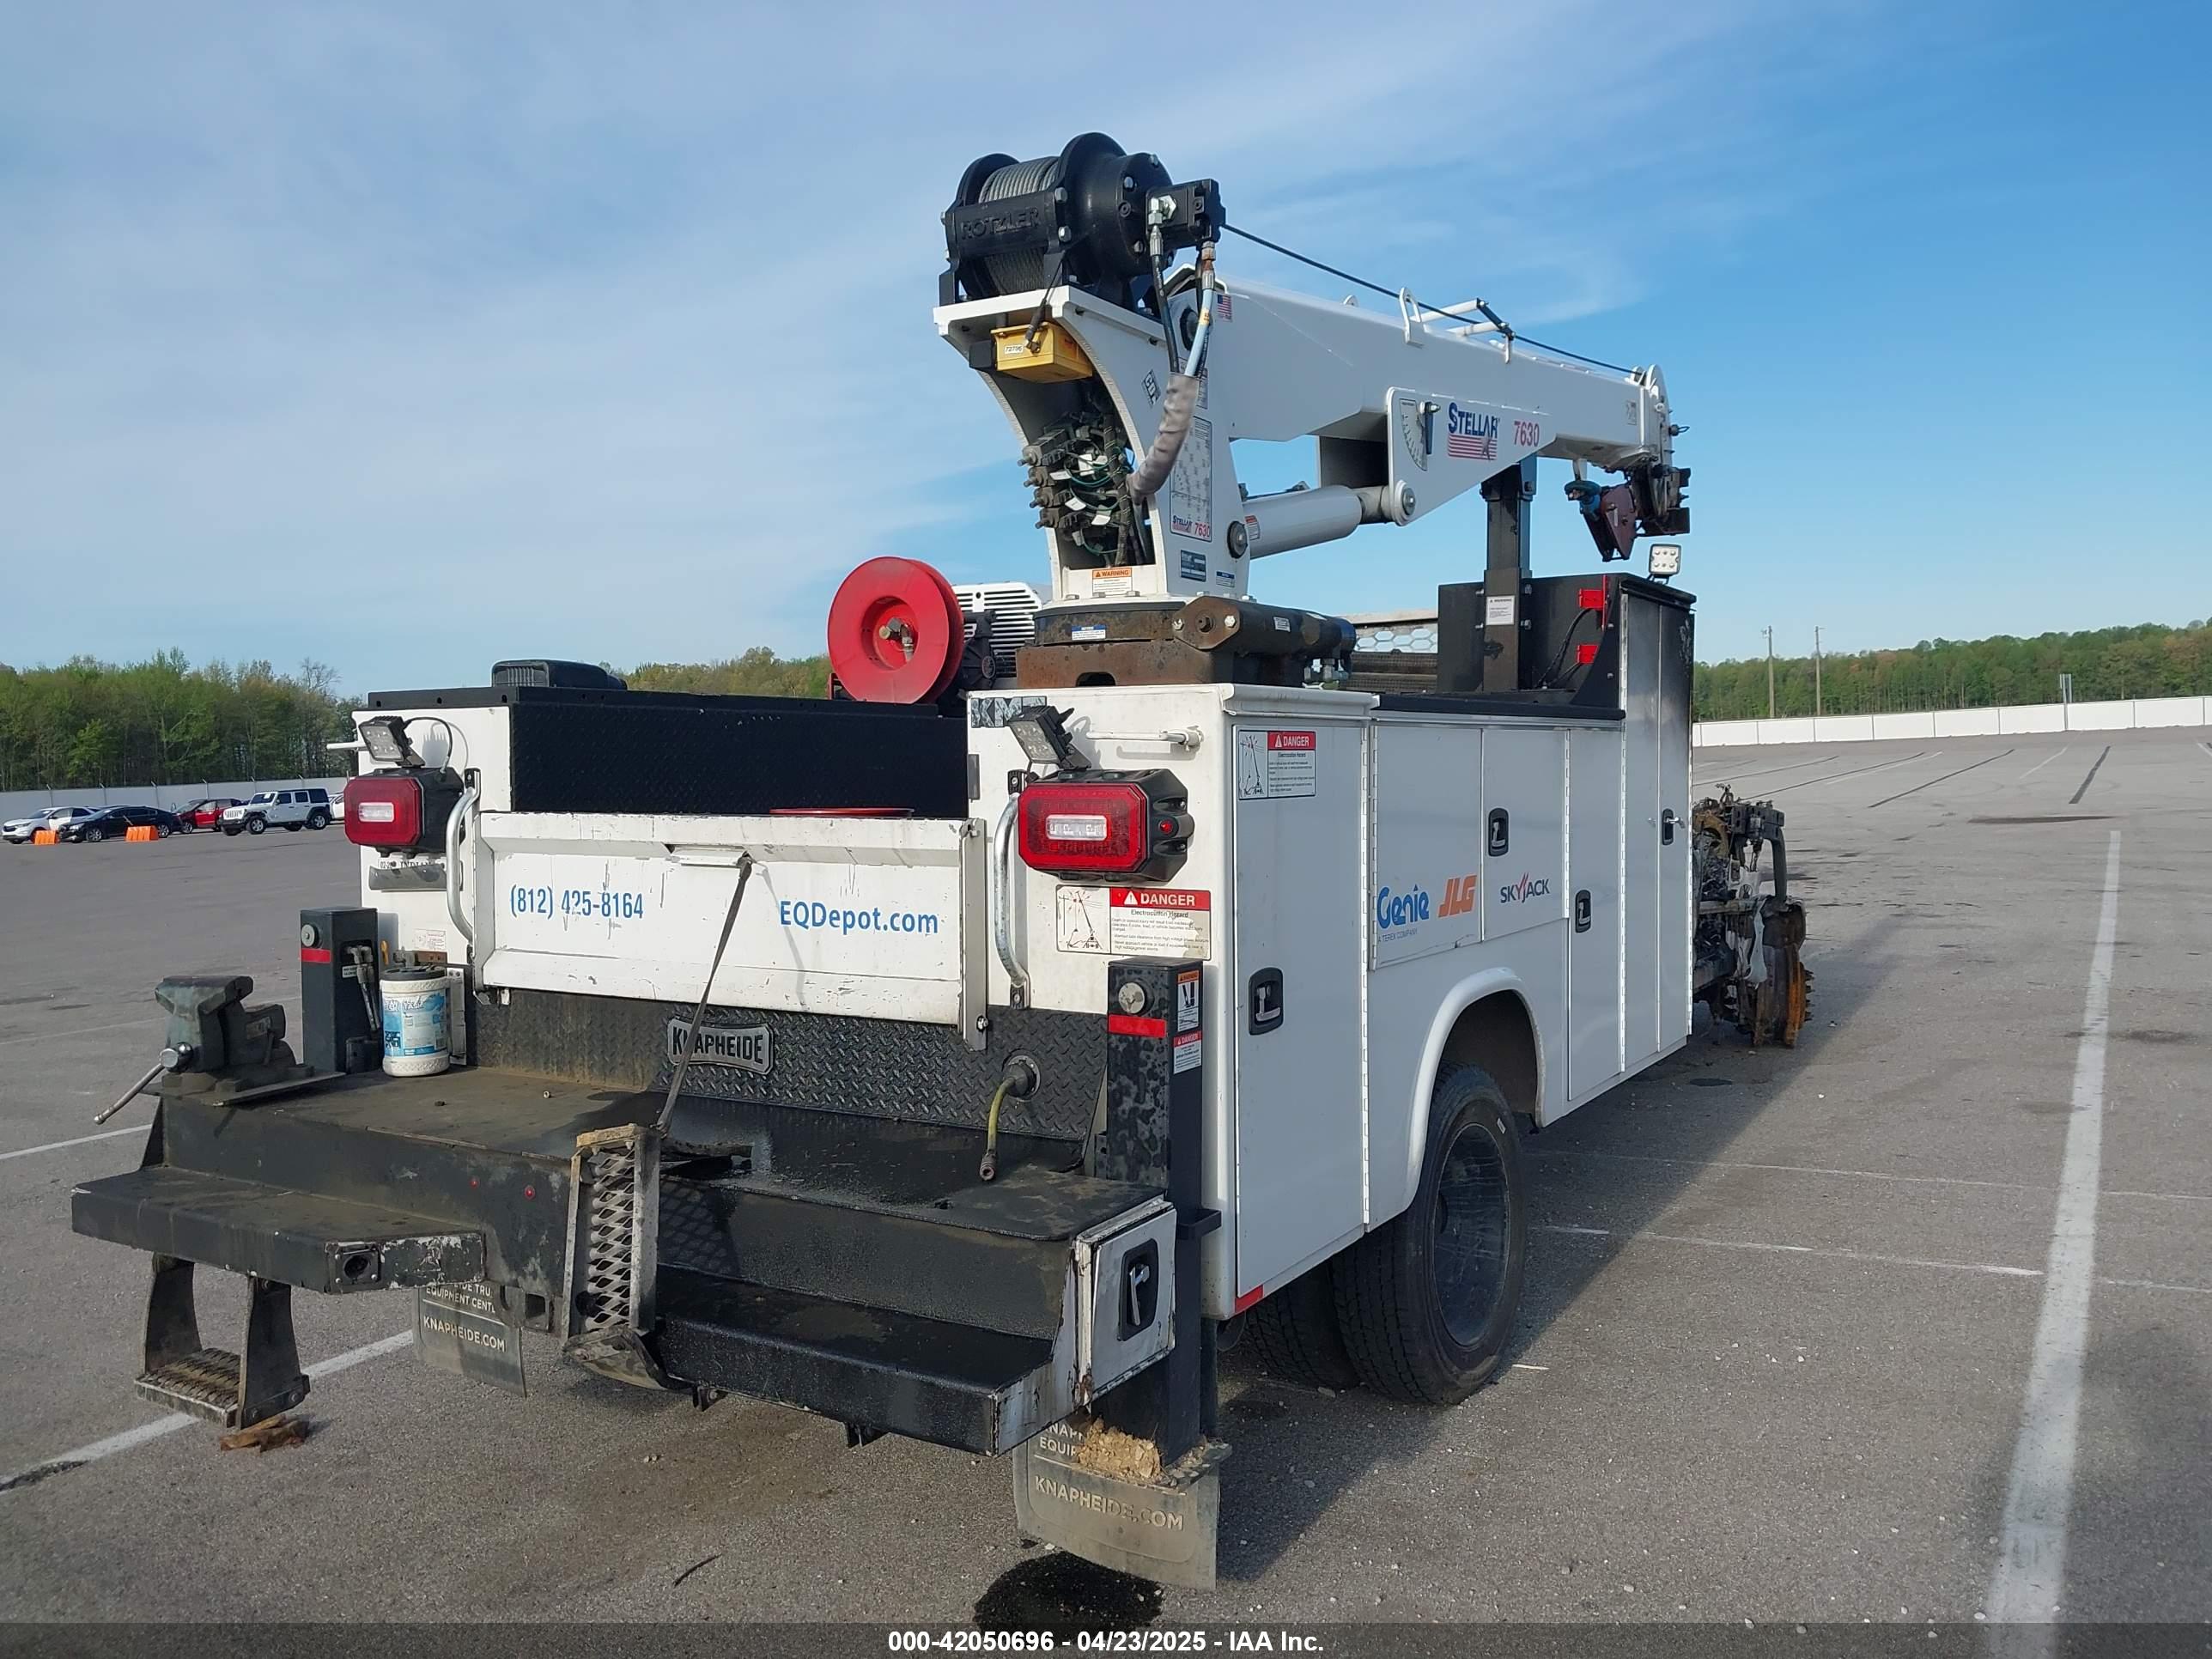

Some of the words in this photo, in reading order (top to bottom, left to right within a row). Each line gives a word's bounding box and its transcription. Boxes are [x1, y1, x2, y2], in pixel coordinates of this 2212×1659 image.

[1449, 402, 1498, 440] STELLAR
[1514, 420, 1540, 447] 7630
[970, 696, 1048, 728] KM
[1283, 736, 1310, 747] DANGER
[511, 884, 554, 920] (812)
[561, 890, 643, 919] 425-8164
[1140, 893, 1195, 906] DANGER
[1438, 875, 1477, 918] JLG
[1500, 872, 1550, 903] SKYJACK
[780, 901, 938, 935] EQDepot.com
[1376, 884, 1430, 929] Genie
[426, 1287, 470, 1305] EQUIPMENT
[423, 1316, 506, 1352] KNAPHEIDE.COM
[1035, 1475, 1183, 1531] KNAPHEIDE.COM
